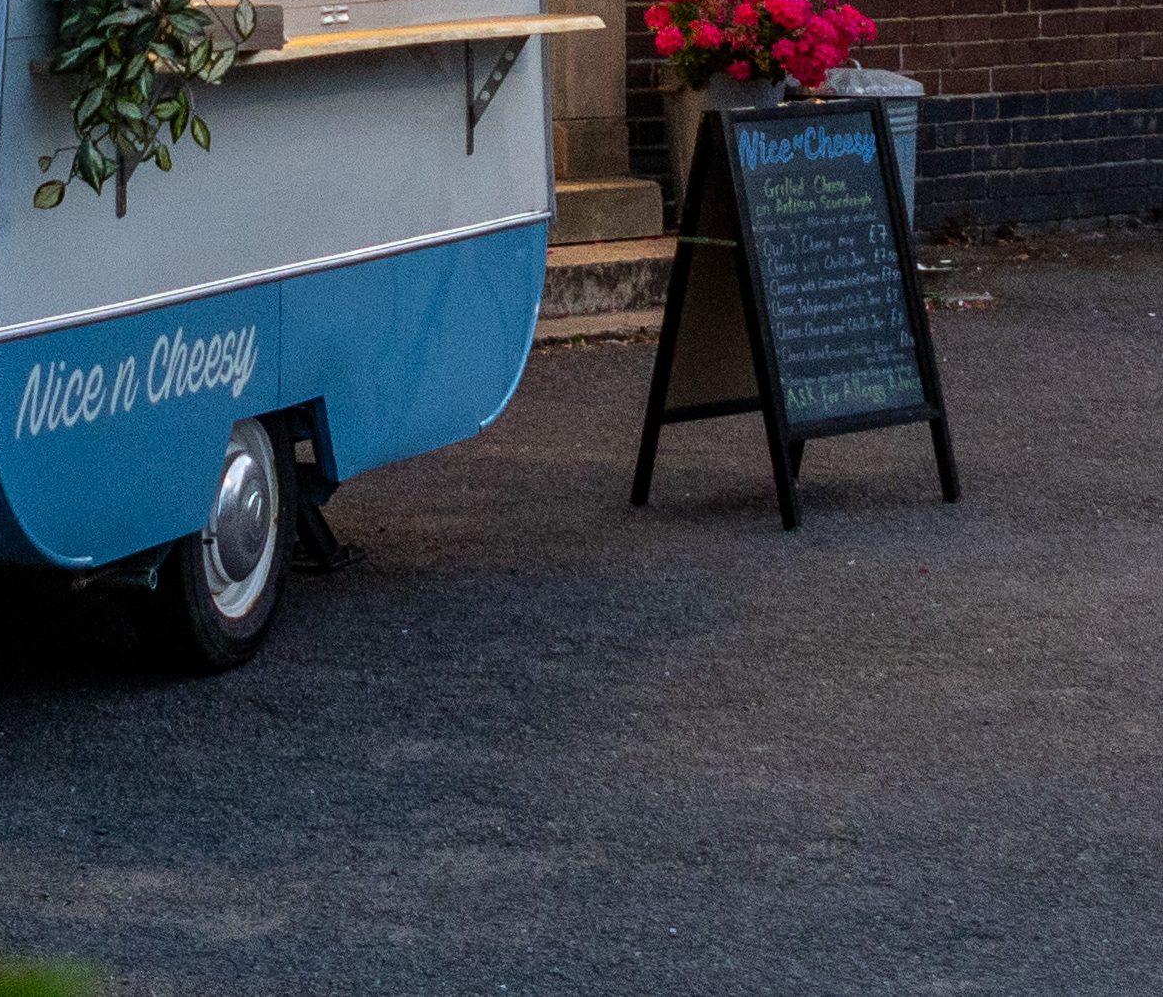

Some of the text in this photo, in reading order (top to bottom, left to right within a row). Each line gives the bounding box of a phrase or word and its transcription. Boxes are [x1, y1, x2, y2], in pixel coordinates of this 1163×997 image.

[739, 129, 794, 171] Nice
[804, 125, 876, 163] Cheesy
[764, 177, 805, 198] Grilled
[776, 196, 816, 215] Artisan
[14, 324, 258, 440] Nice n Cheesy
